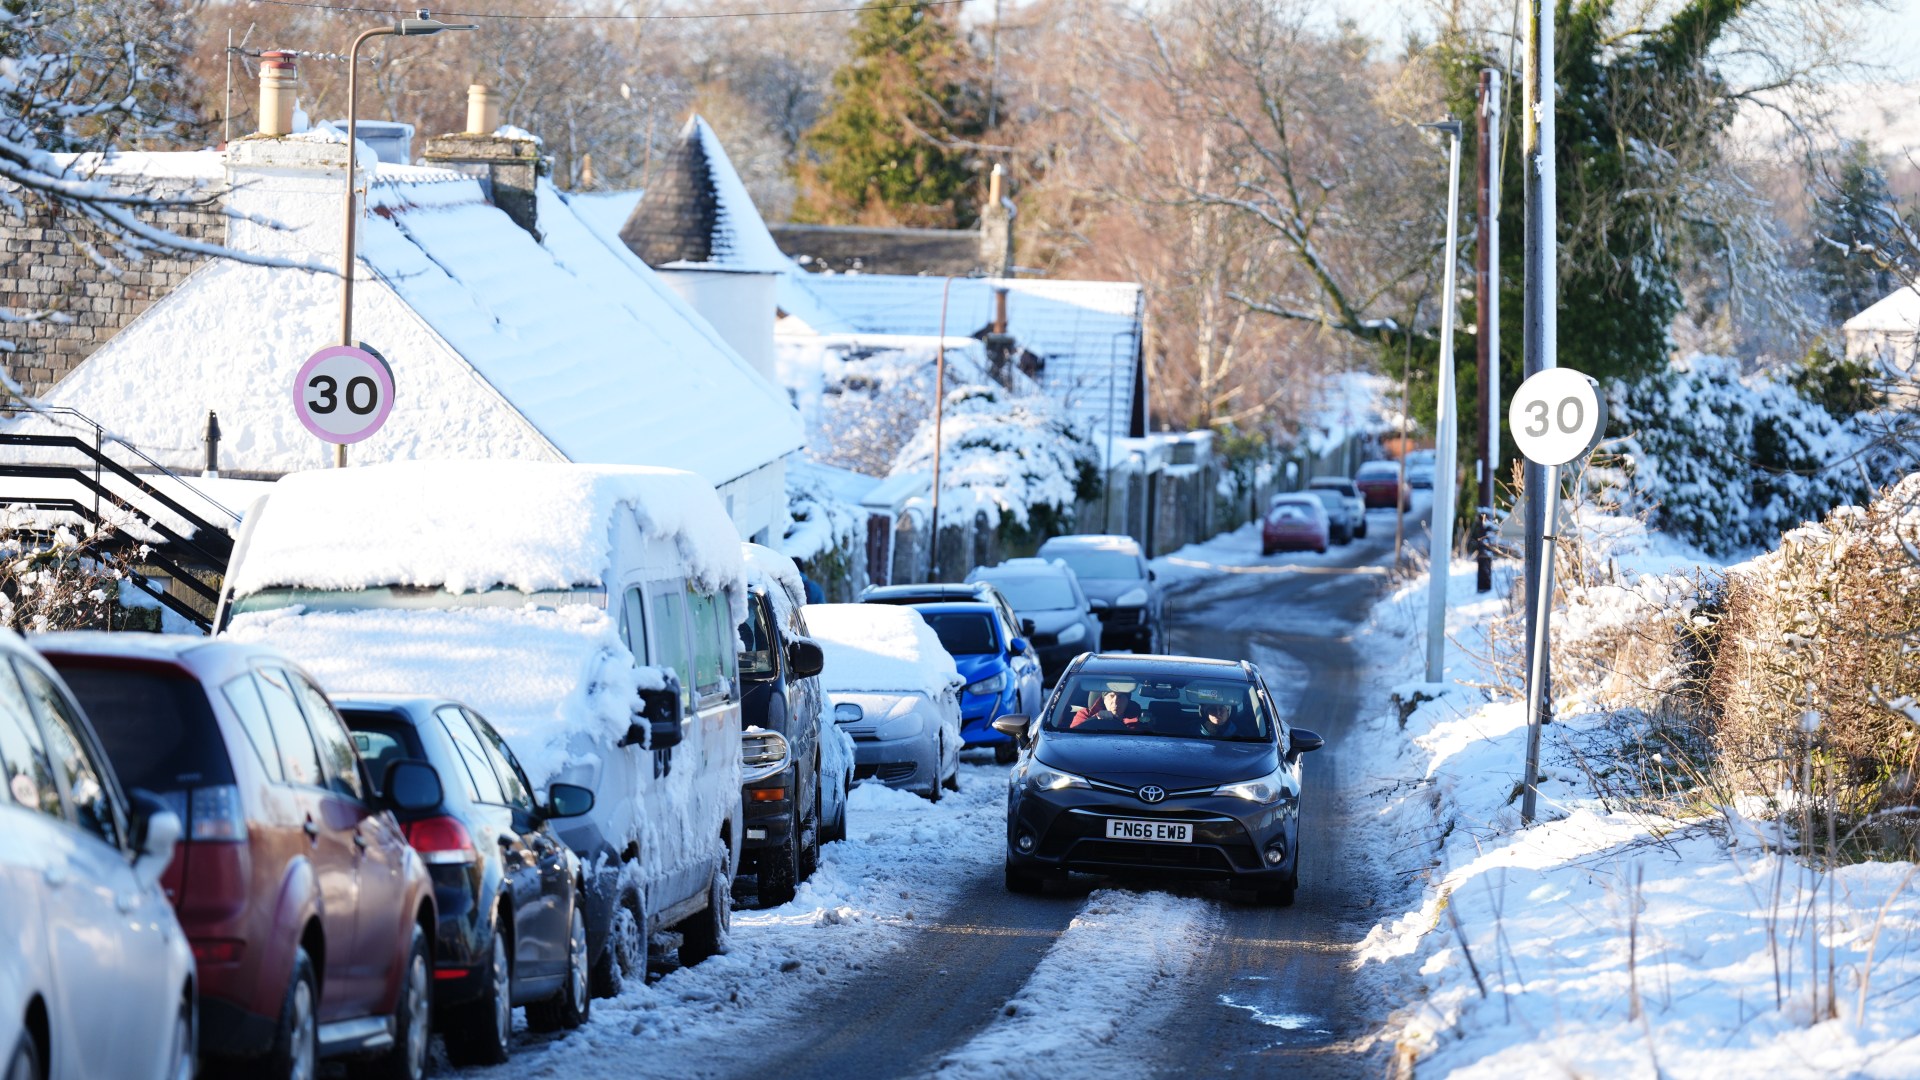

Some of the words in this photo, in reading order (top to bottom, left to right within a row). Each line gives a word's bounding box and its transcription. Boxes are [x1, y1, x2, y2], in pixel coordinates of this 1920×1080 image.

[308, 375, 378, 415] 30
[1524, 396, 1584, 438] 30
[1113, 822, 1152, 838] FN66
[1157, 824, 1187, 839] EWB
